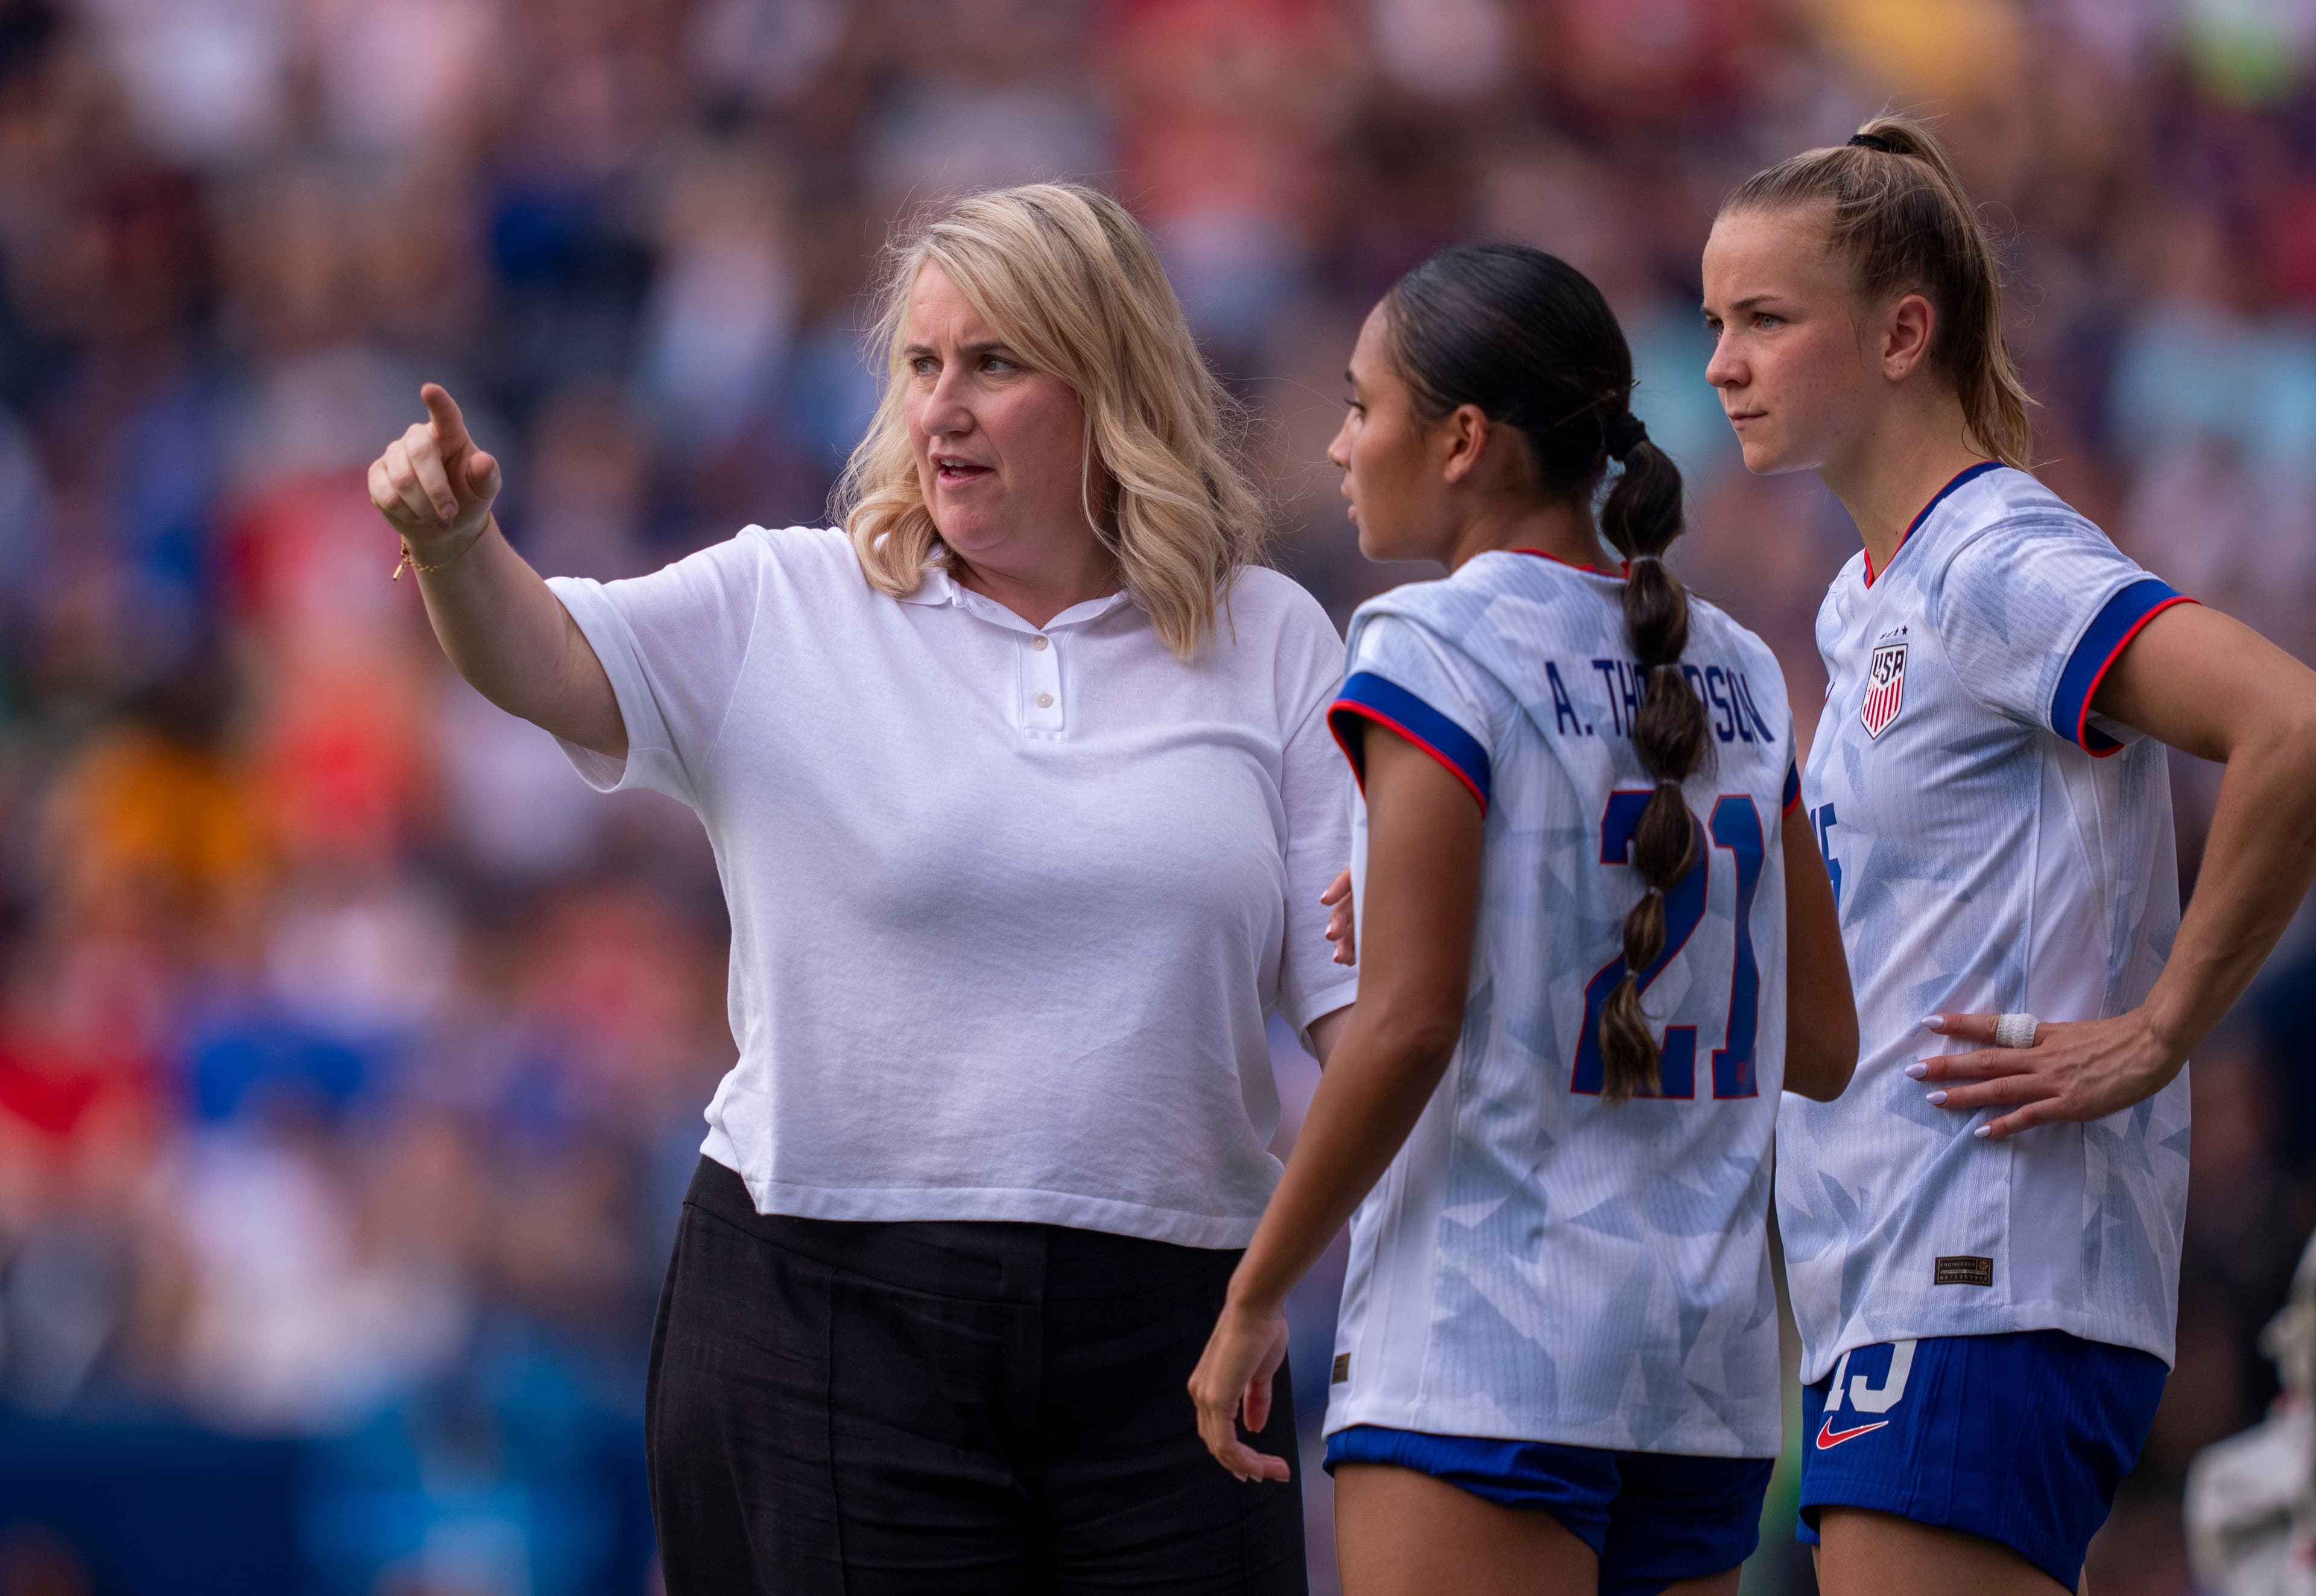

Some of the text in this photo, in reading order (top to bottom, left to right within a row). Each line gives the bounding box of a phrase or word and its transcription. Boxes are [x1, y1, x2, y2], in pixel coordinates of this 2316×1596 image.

[1545, 660, 1593, 736] A.
[1873, 650, 1905, 685] USA
[1570, 789, 1765, 1100] 21
